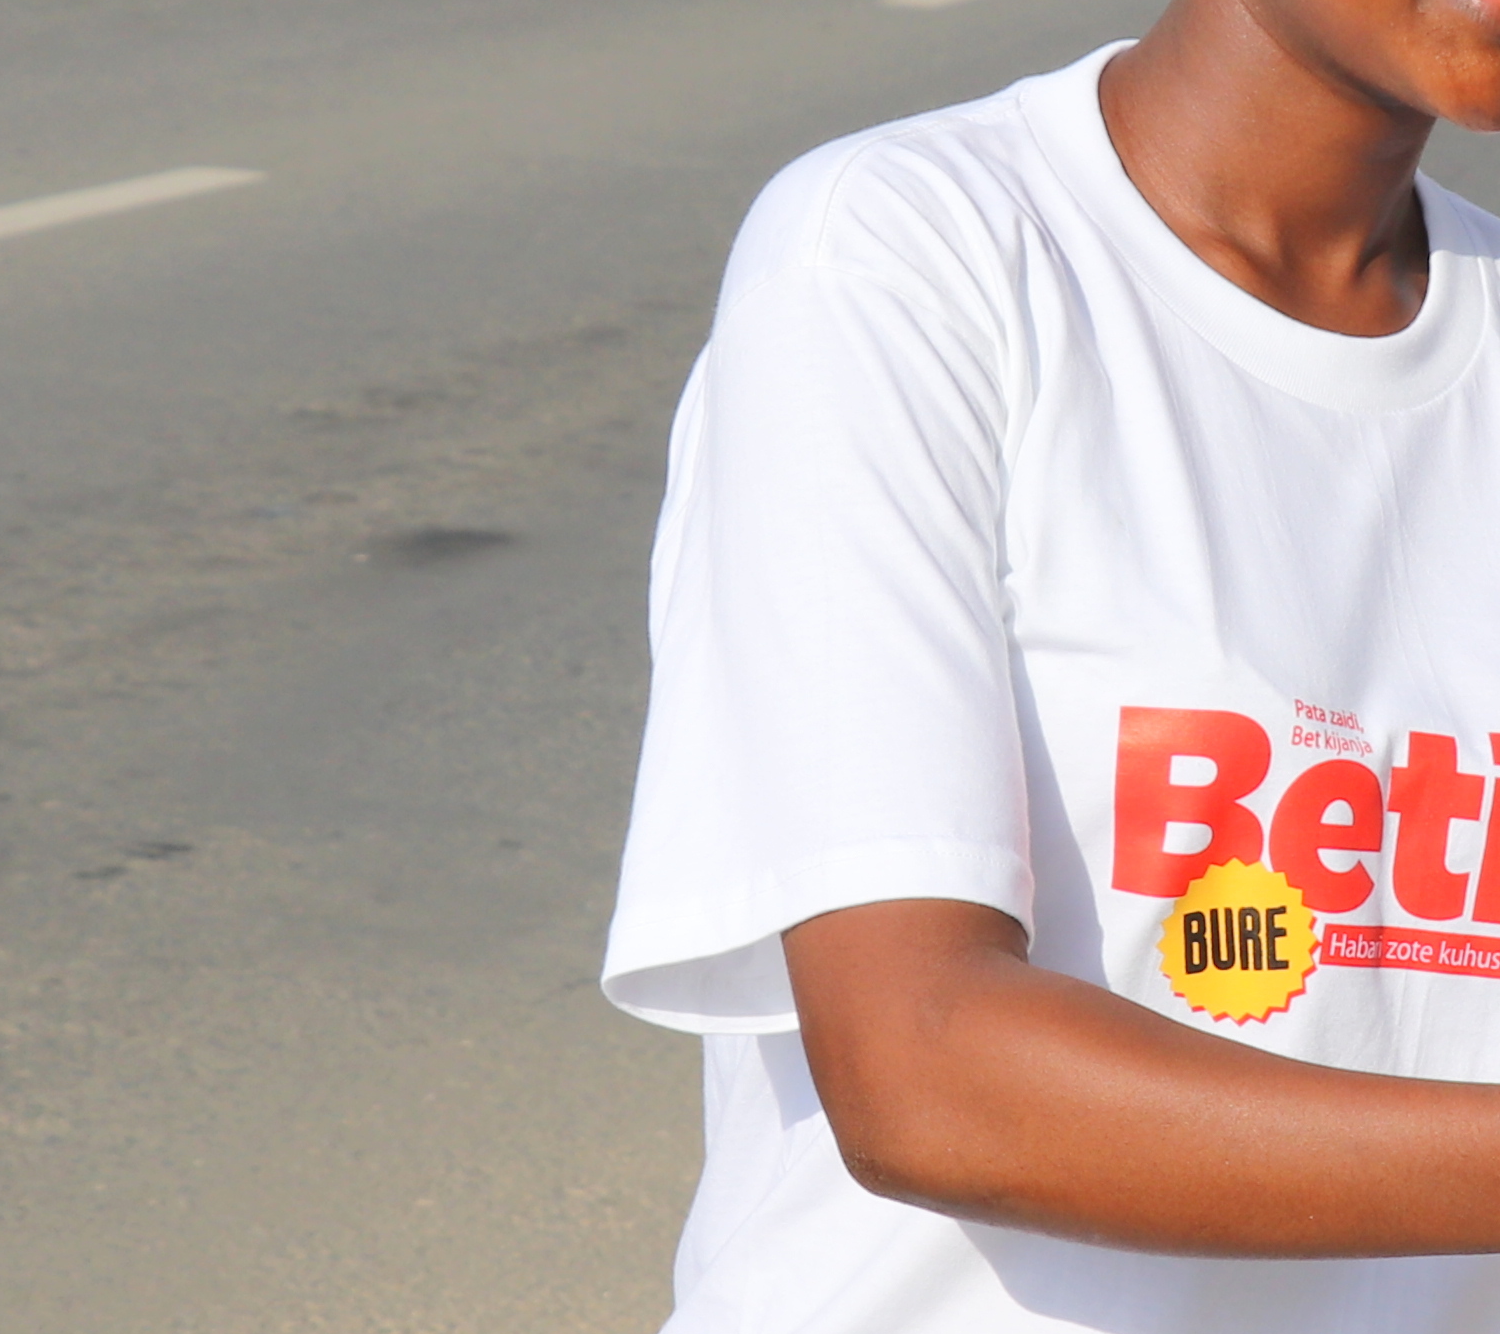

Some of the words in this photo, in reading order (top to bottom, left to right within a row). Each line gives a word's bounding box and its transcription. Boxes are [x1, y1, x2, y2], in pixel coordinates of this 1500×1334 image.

[1294, 699, 1327, 723] Pata
[1329, 710, 1364, 734] zaidi,
[1291, 725, 1321, 749] Bet
[1324, 730, 1374, 758] kijanja
[1183, 905, 1290, 975] BURE
[1329, 932, 1383, 959] Habari
[1385, 938, 1434, 964] zote
